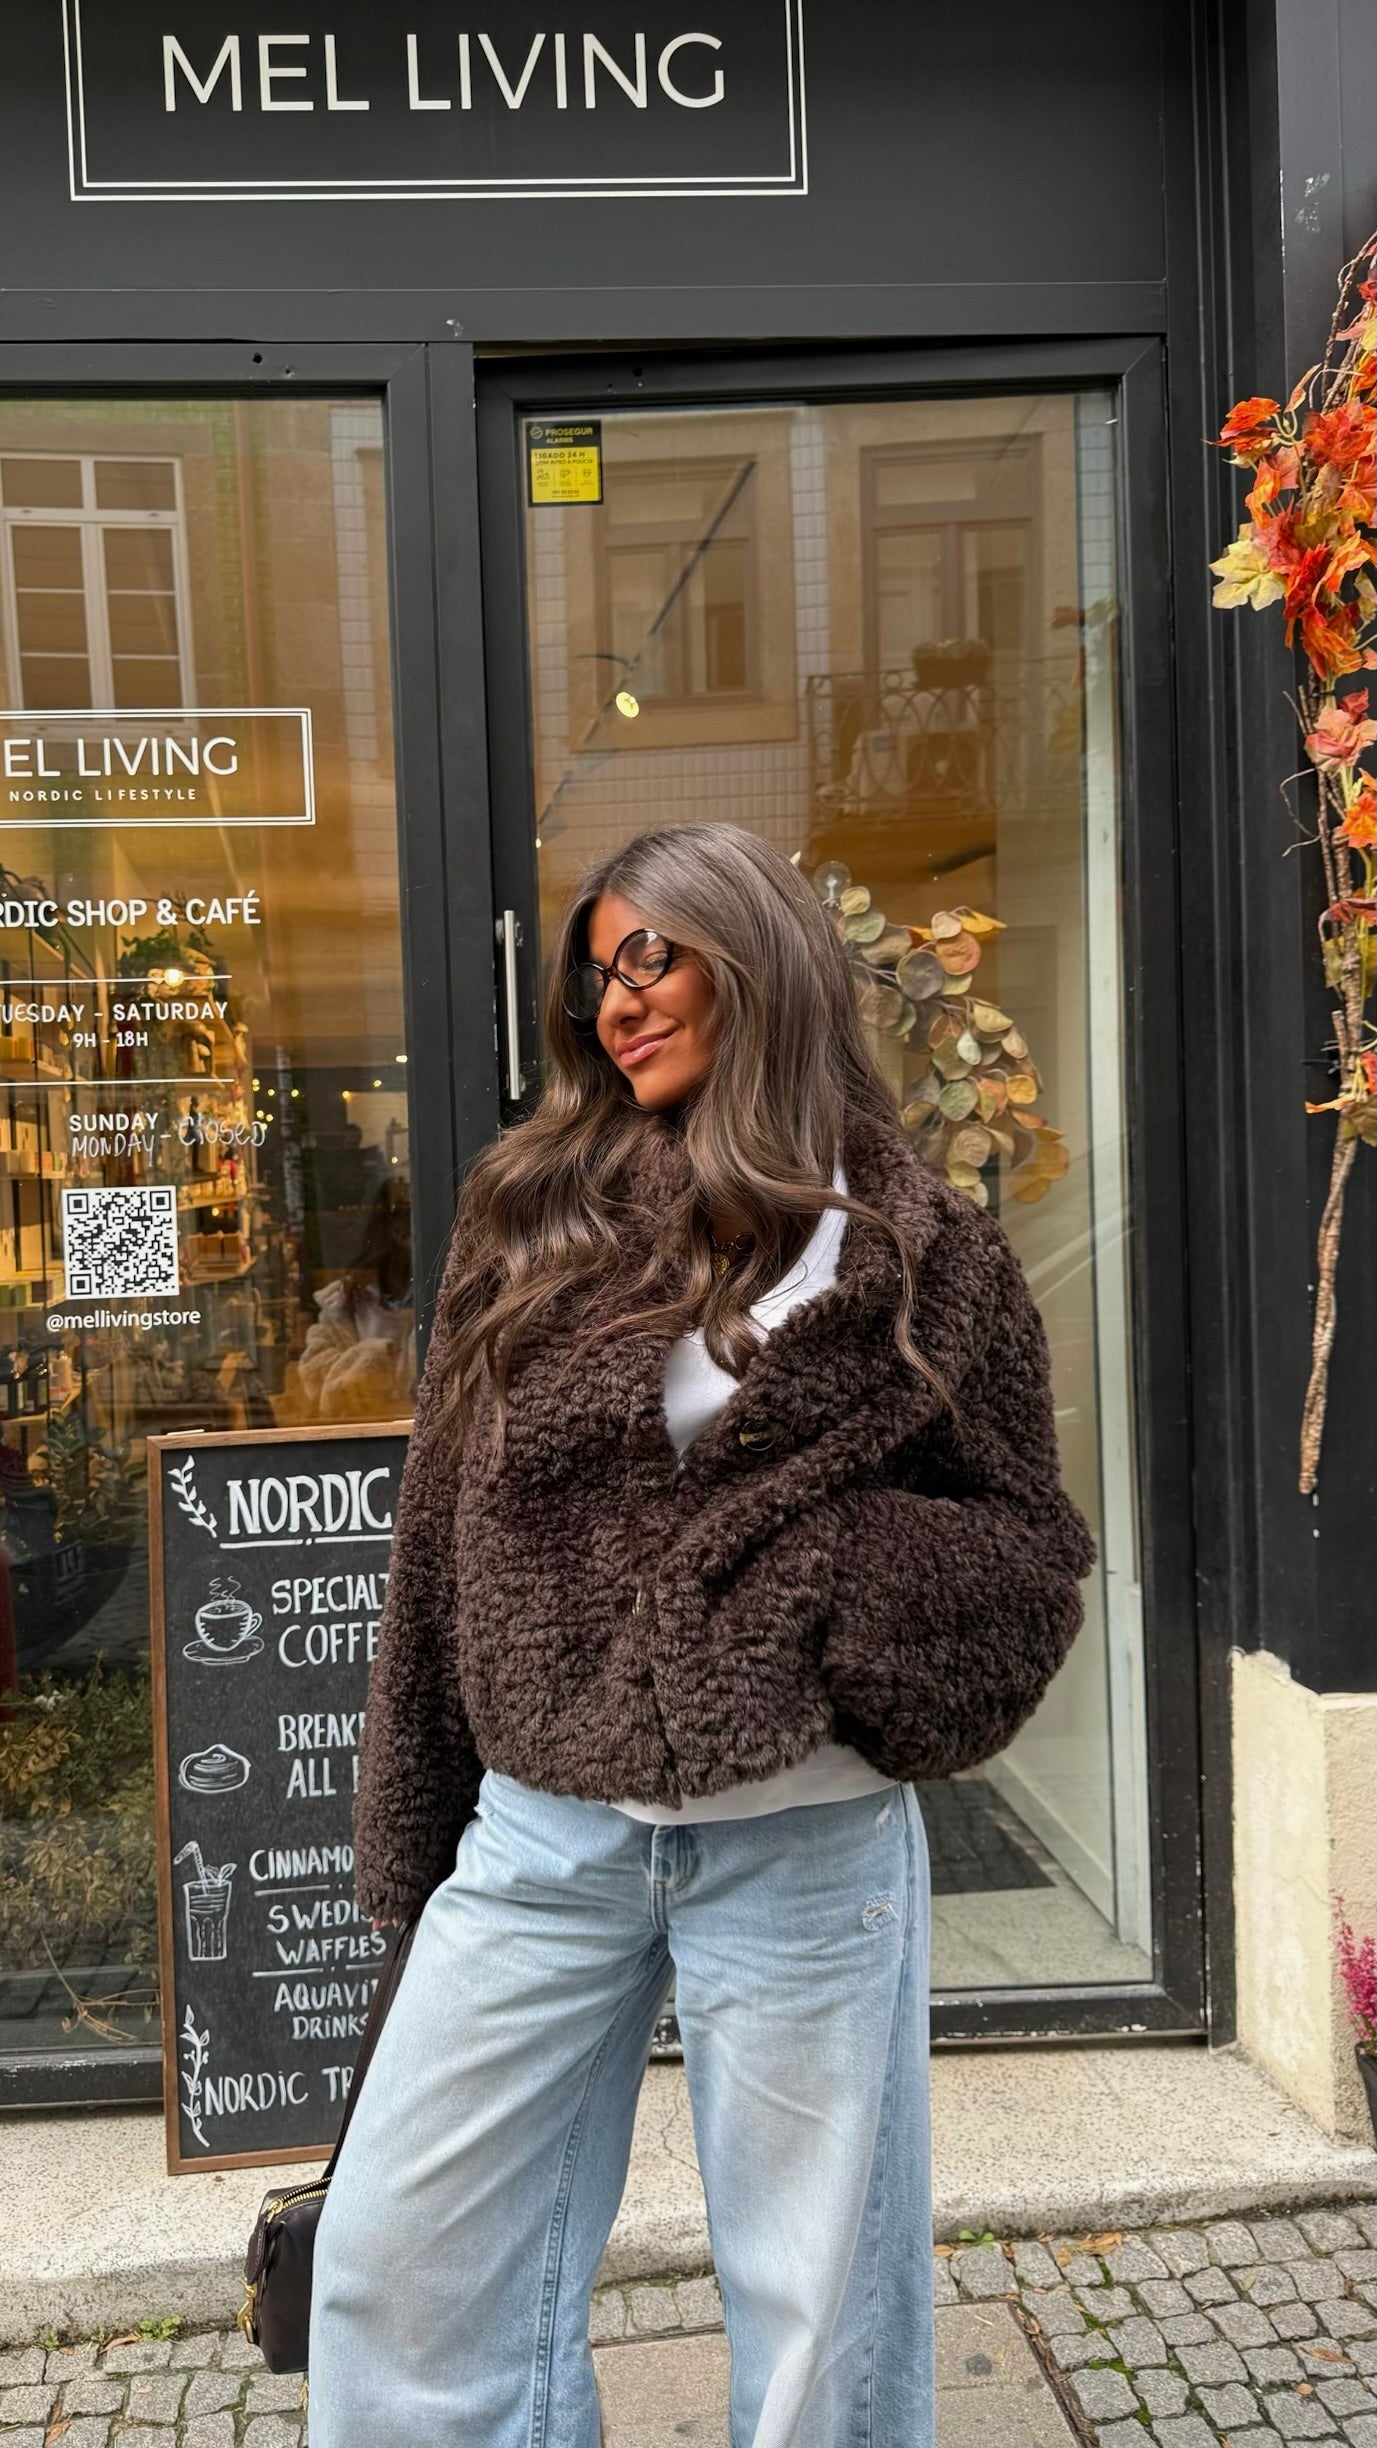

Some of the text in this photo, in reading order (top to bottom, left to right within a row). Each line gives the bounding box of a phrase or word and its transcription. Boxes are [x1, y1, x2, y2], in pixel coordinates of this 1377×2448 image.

[163, 33, 725, 111] MEL LIVING
[544, 427, 594, 437] PROSEGUR
[78, 738, 238, 776] LIVING
[10, 788, 197, 801] NORDIC LIFESTYLE
[0, 890, 261, 928] DIC SHOP & CAFÉ
[0, 1003, 85, 1024] UESDAY
[113, 1001, 228, 1021] SATURDAY
[73, 1033, 97, 1048] 9H
[116, 1031, 149, 1047] 18H
[69, 1112, 159, 1132] SUNDAY
[46, 1309, 201, 1332] @mellivingstore
[227, 1467, 394, 1536] NORDIC
[278, 1620, 382, 1668] COFFE
[286, 1755, 337, 1799] ALL
[275, 1930, 387, 1966] WAFFLES
